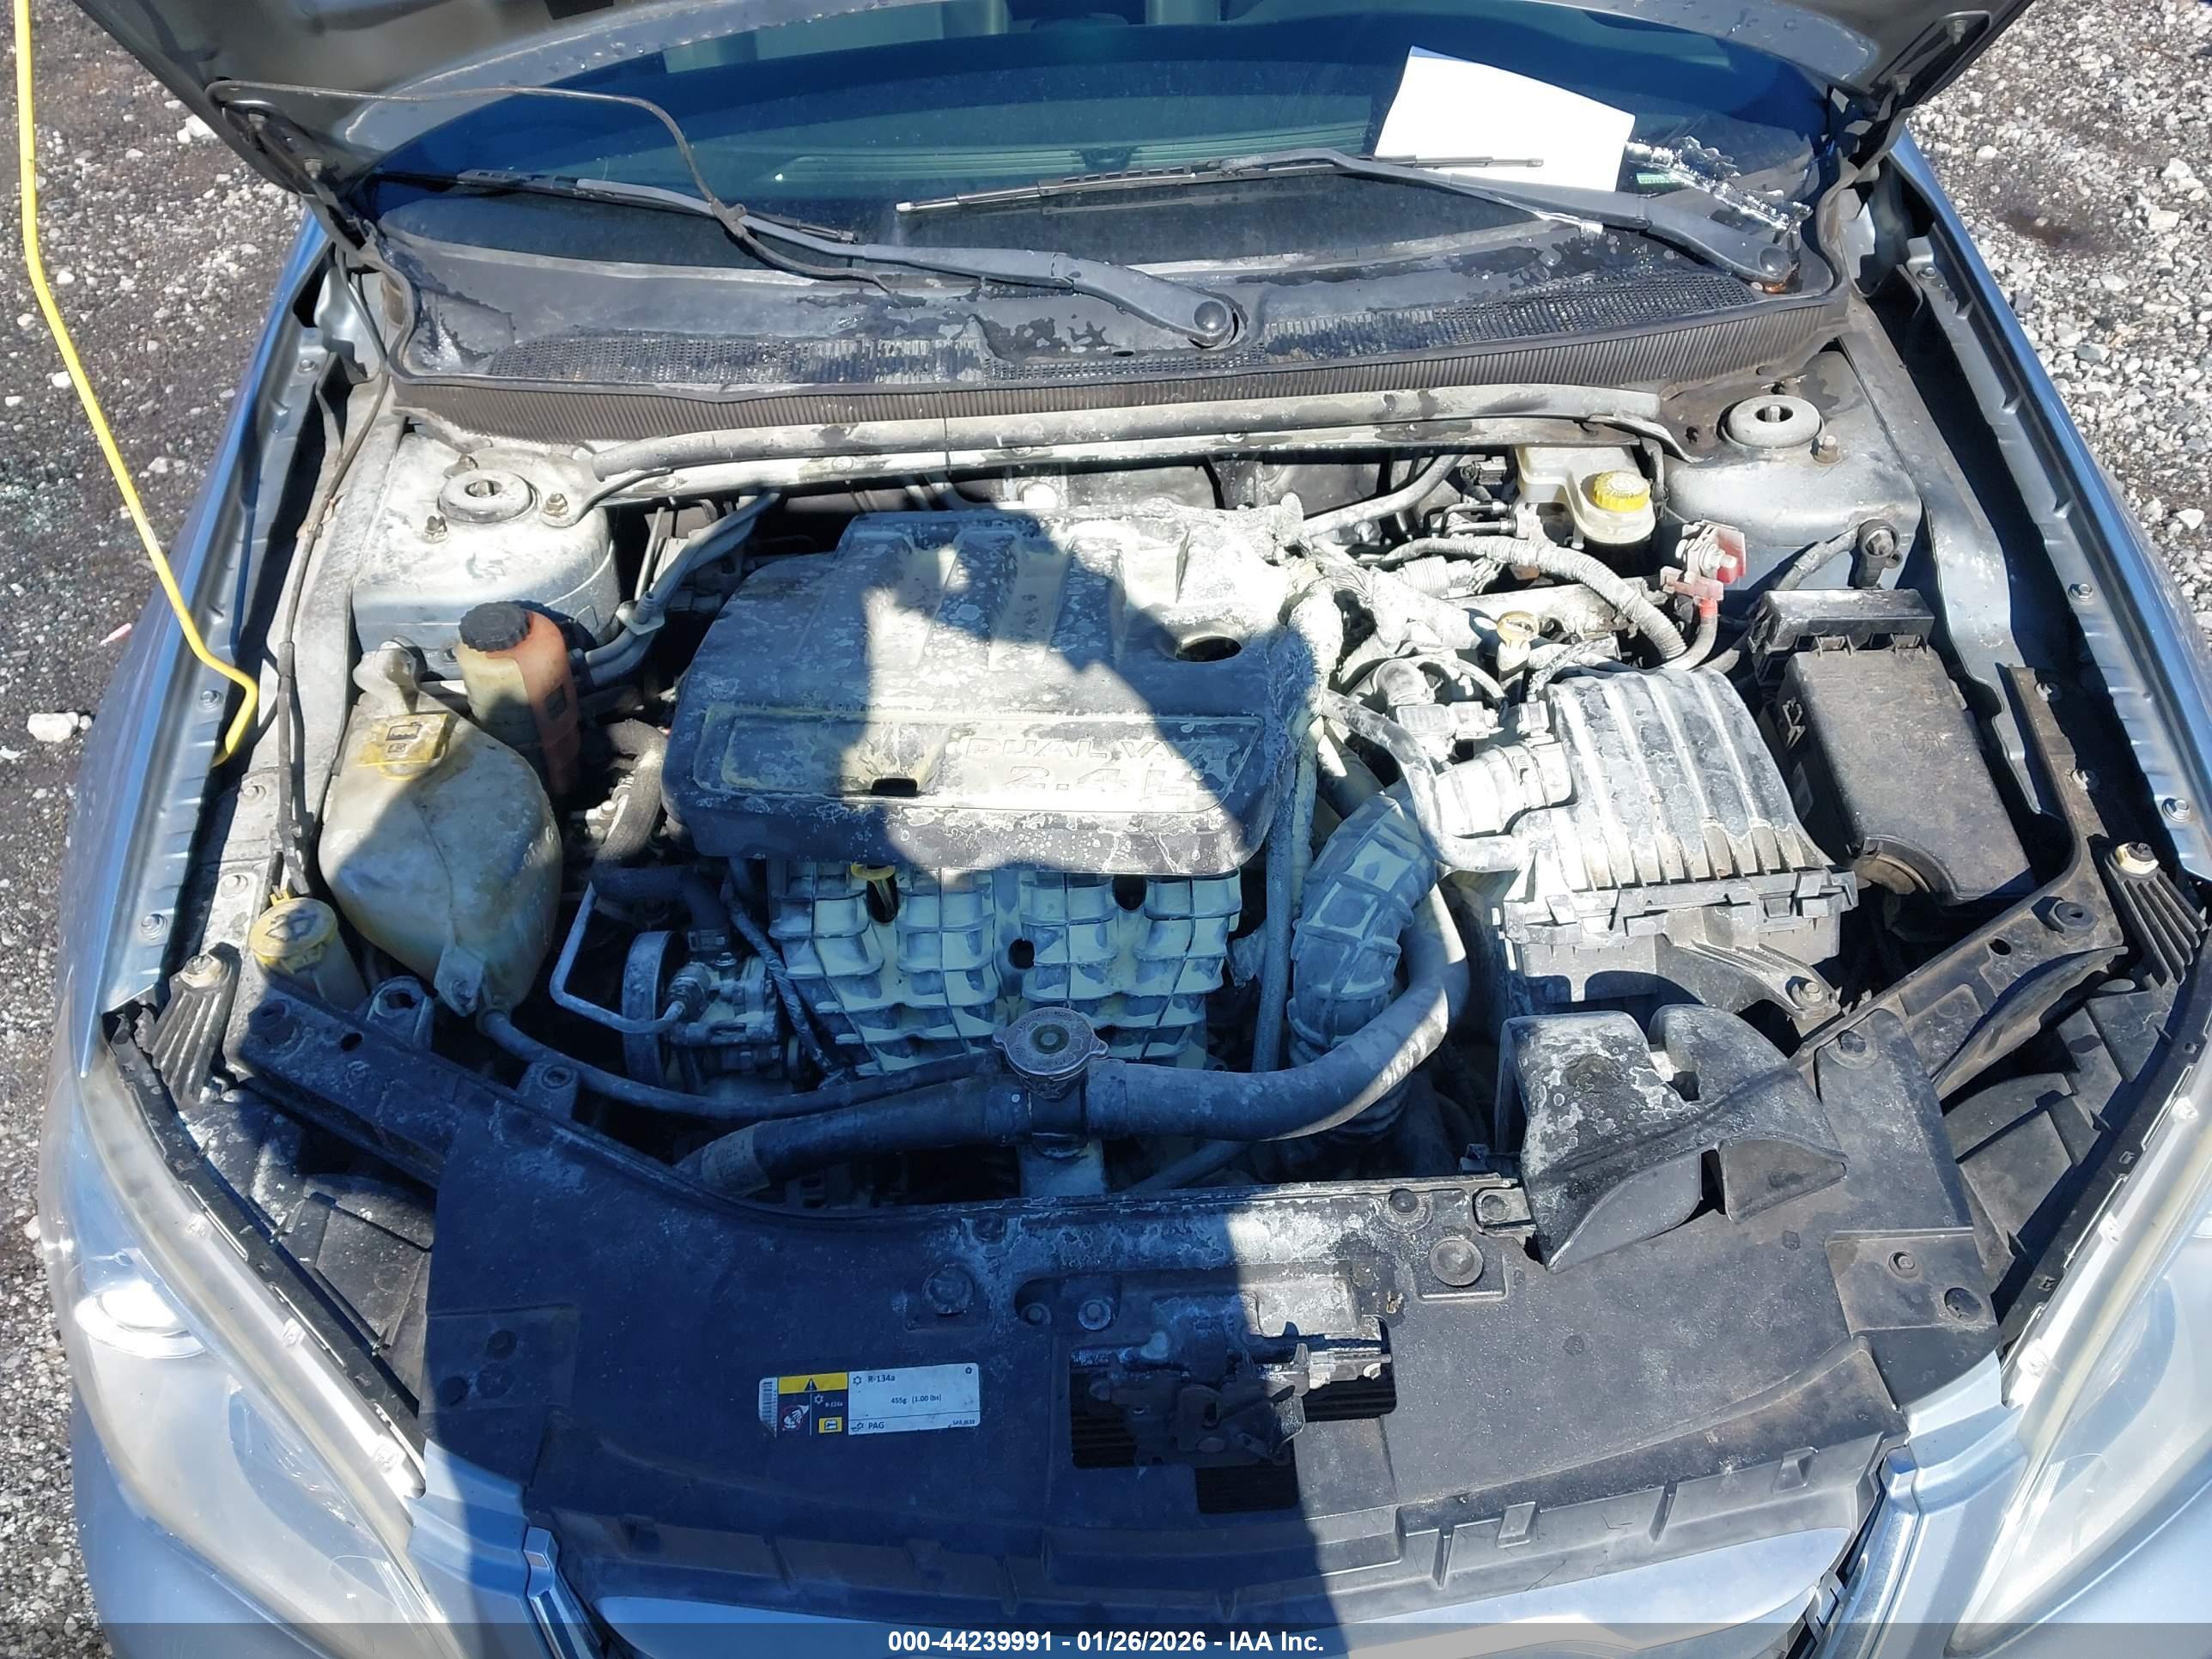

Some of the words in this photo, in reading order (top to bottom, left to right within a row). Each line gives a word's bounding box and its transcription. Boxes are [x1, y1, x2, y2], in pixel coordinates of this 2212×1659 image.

[963, 736, 1109, 760] DUAL
[867, 1375, 896, 1383] R-134a
[890, 1396, 908, 1406] 455g
[911, 1395, 929, 1405] (1.00
[868, 1421, 885, 1431] PAG
